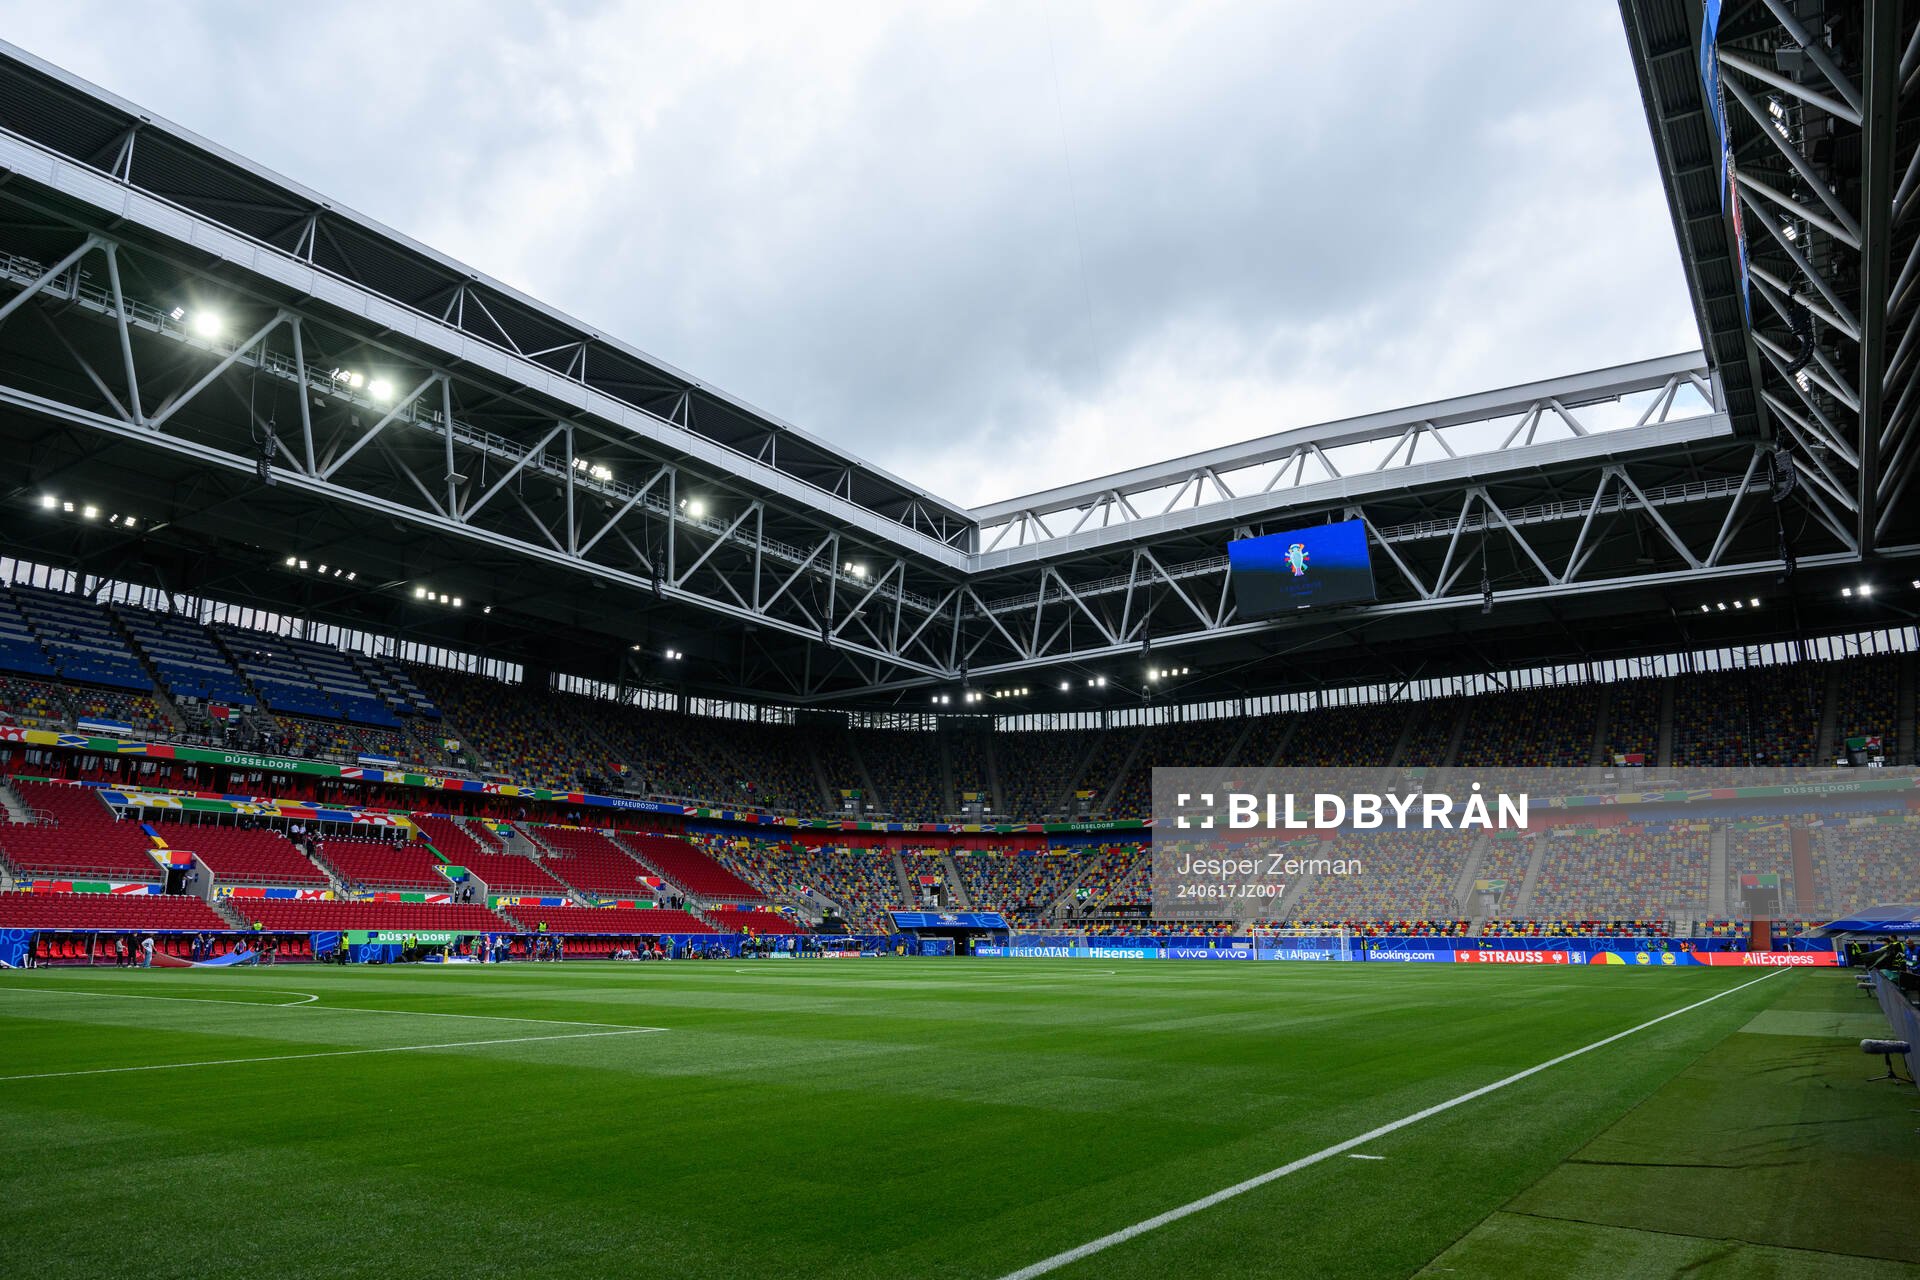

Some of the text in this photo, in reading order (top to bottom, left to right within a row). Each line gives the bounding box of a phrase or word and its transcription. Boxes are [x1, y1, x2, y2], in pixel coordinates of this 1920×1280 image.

[224, 754, 298, 770] DÜSSELDORF
[1783, 783, 1861, 794] DÜSSELDORF
[1071, 822, 1115, 830] DÜSSELDORF
[1089, 948, 1144, 959] Hisense
[1177, 950, 1248, 959] vivo vivo
[1370, 950, 1435, 961] Booking.com
[1479, 951, 1544, 962] STRAUSS
[1743, 952, 1815, 966] AliExpress
